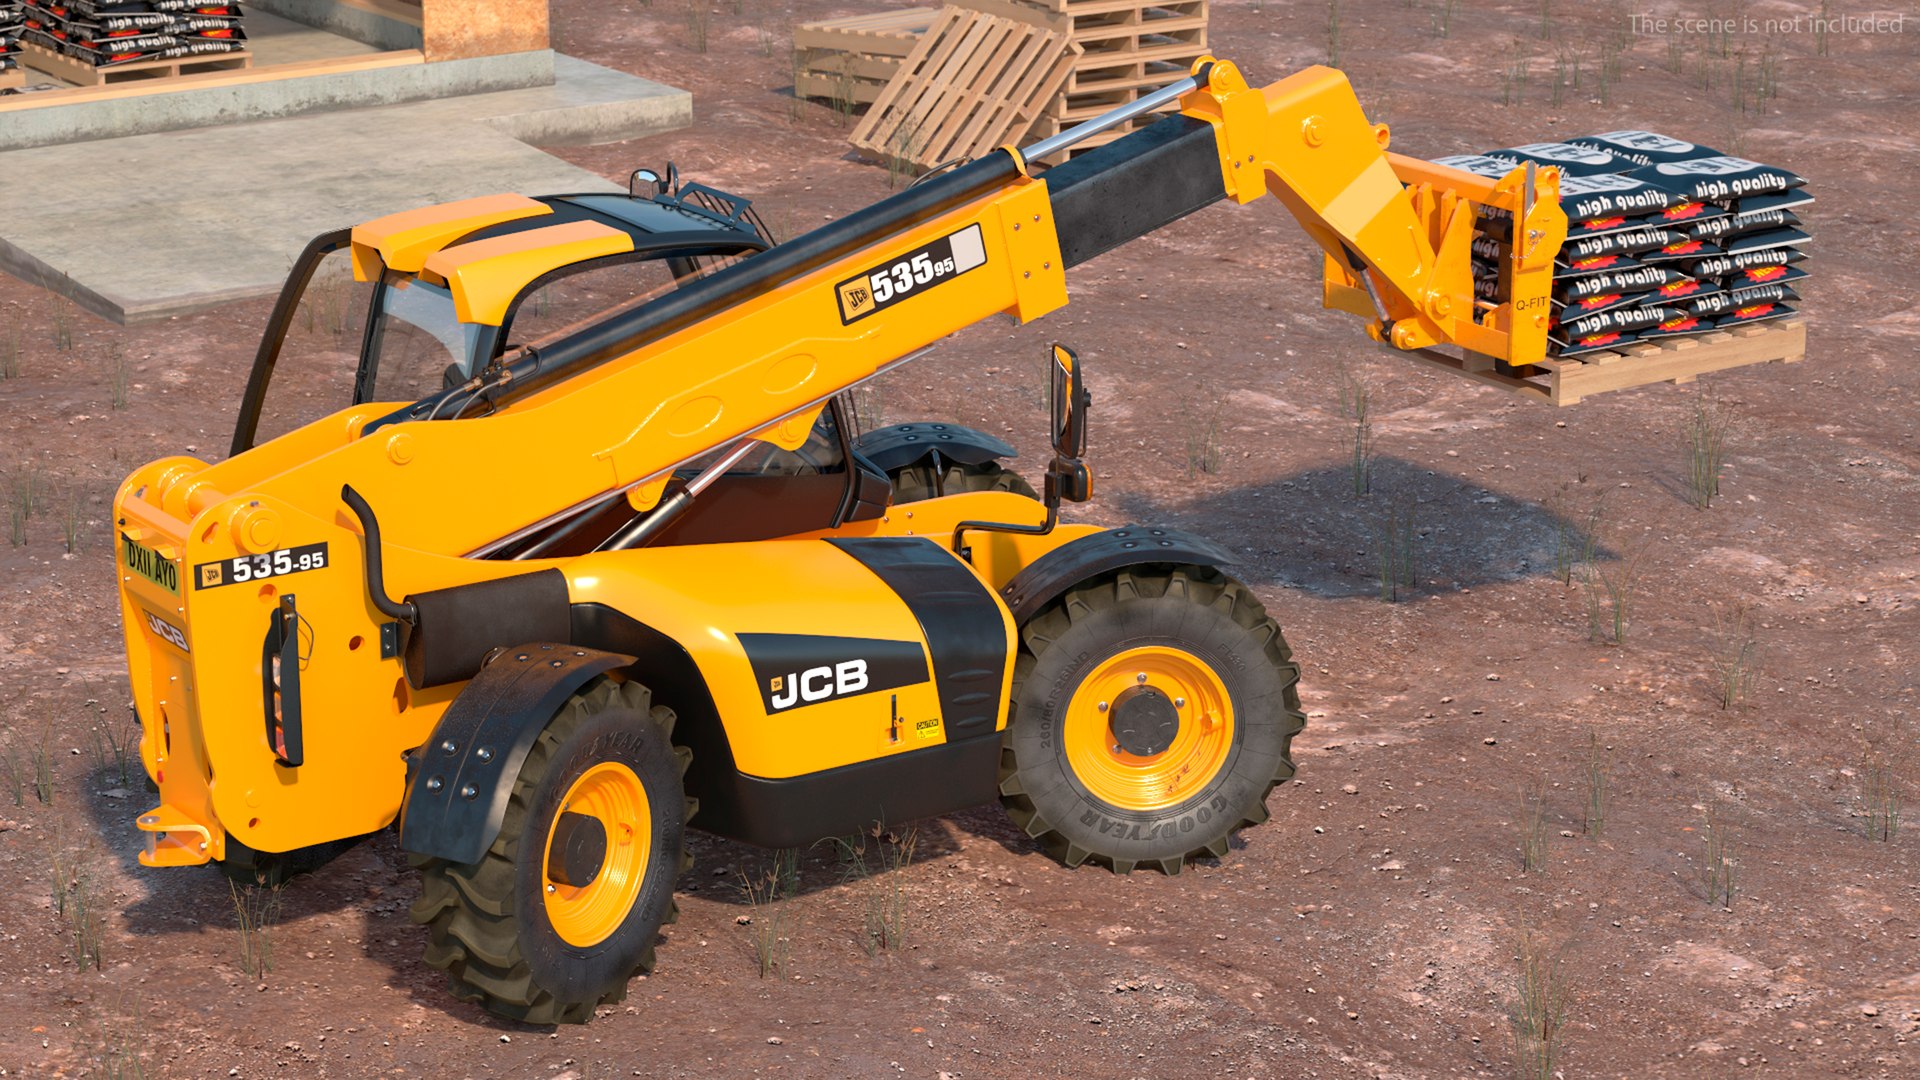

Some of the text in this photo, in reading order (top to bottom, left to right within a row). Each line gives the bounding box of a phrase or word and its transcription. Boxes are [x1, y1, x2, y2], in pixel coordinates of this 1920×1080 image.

[1696, 173, 1787, 199] high quality
[1577, 189, 1668, 217] high quality
[1697, 209, 1784, 235] high quality
[1578, 227, 1668, 254] high quality
[1701, 249, 1788, 275] high quality
[849, 252, 954, 308] JCB 535 95
[1576, 267, 1667, 294] high quality
[1516, 297, 1547, 311] Q-FIT
[1696, 284, 1784, 311] high quality
[1577, 305, 1665, 333] high quality
[155, 558, 176, 591] AYO
[233, 549, 324, 583] 535-95
[149, 614, 190, 651] JCB
[771, 659, 869, 709] JCB
[917, 719, 938, 729] CAUTION
[1080, 795, 1227, 840] GOODYEAR
